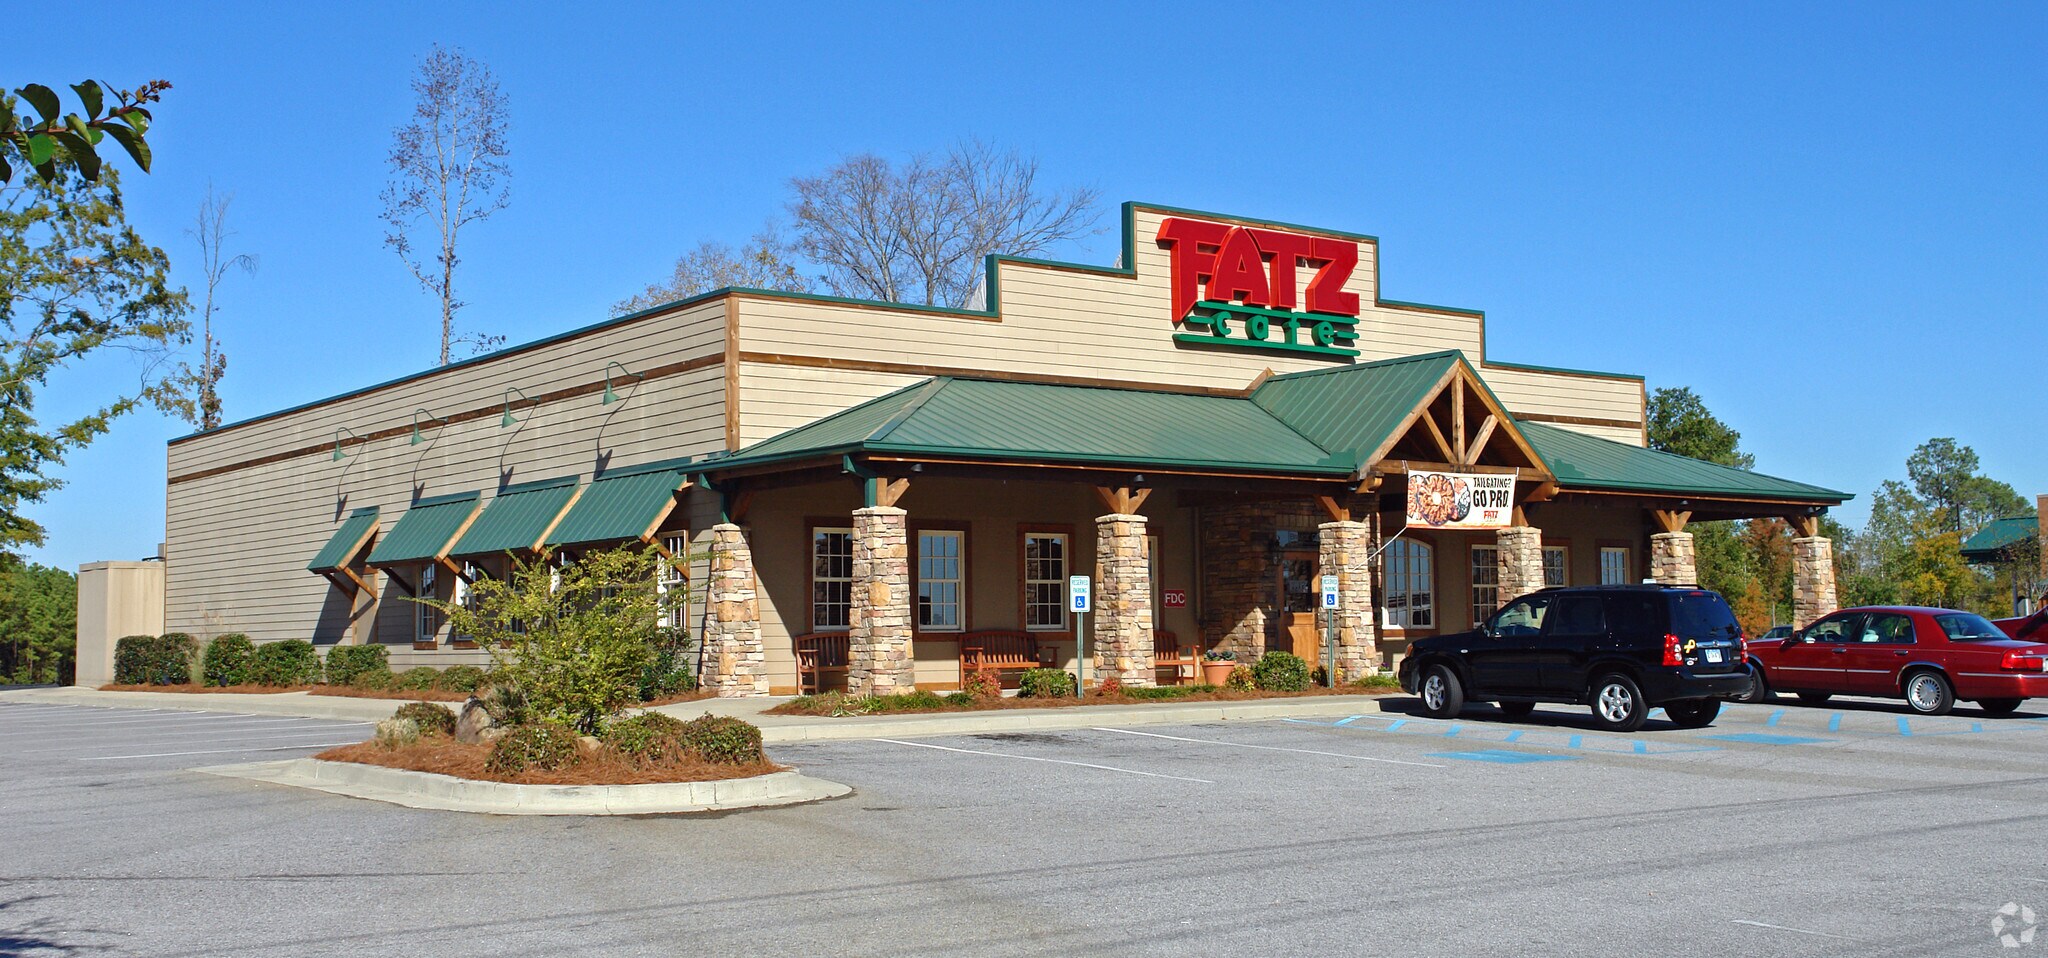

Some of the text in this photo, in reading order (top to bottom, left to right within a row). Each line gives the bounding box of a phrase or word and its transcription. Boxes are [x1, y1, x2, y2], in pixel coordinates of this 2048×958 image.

[1156, 218, 1360, 328] FATZ
[1210, 311, 1335, 347] cafe
[1474, 478, 1511, 488] TAILGATING?
[1473, 490, 1487, 507] GO
[1484, 510, 1498, 519] FATZ
[1164, 592, 1185, 604] FDC
